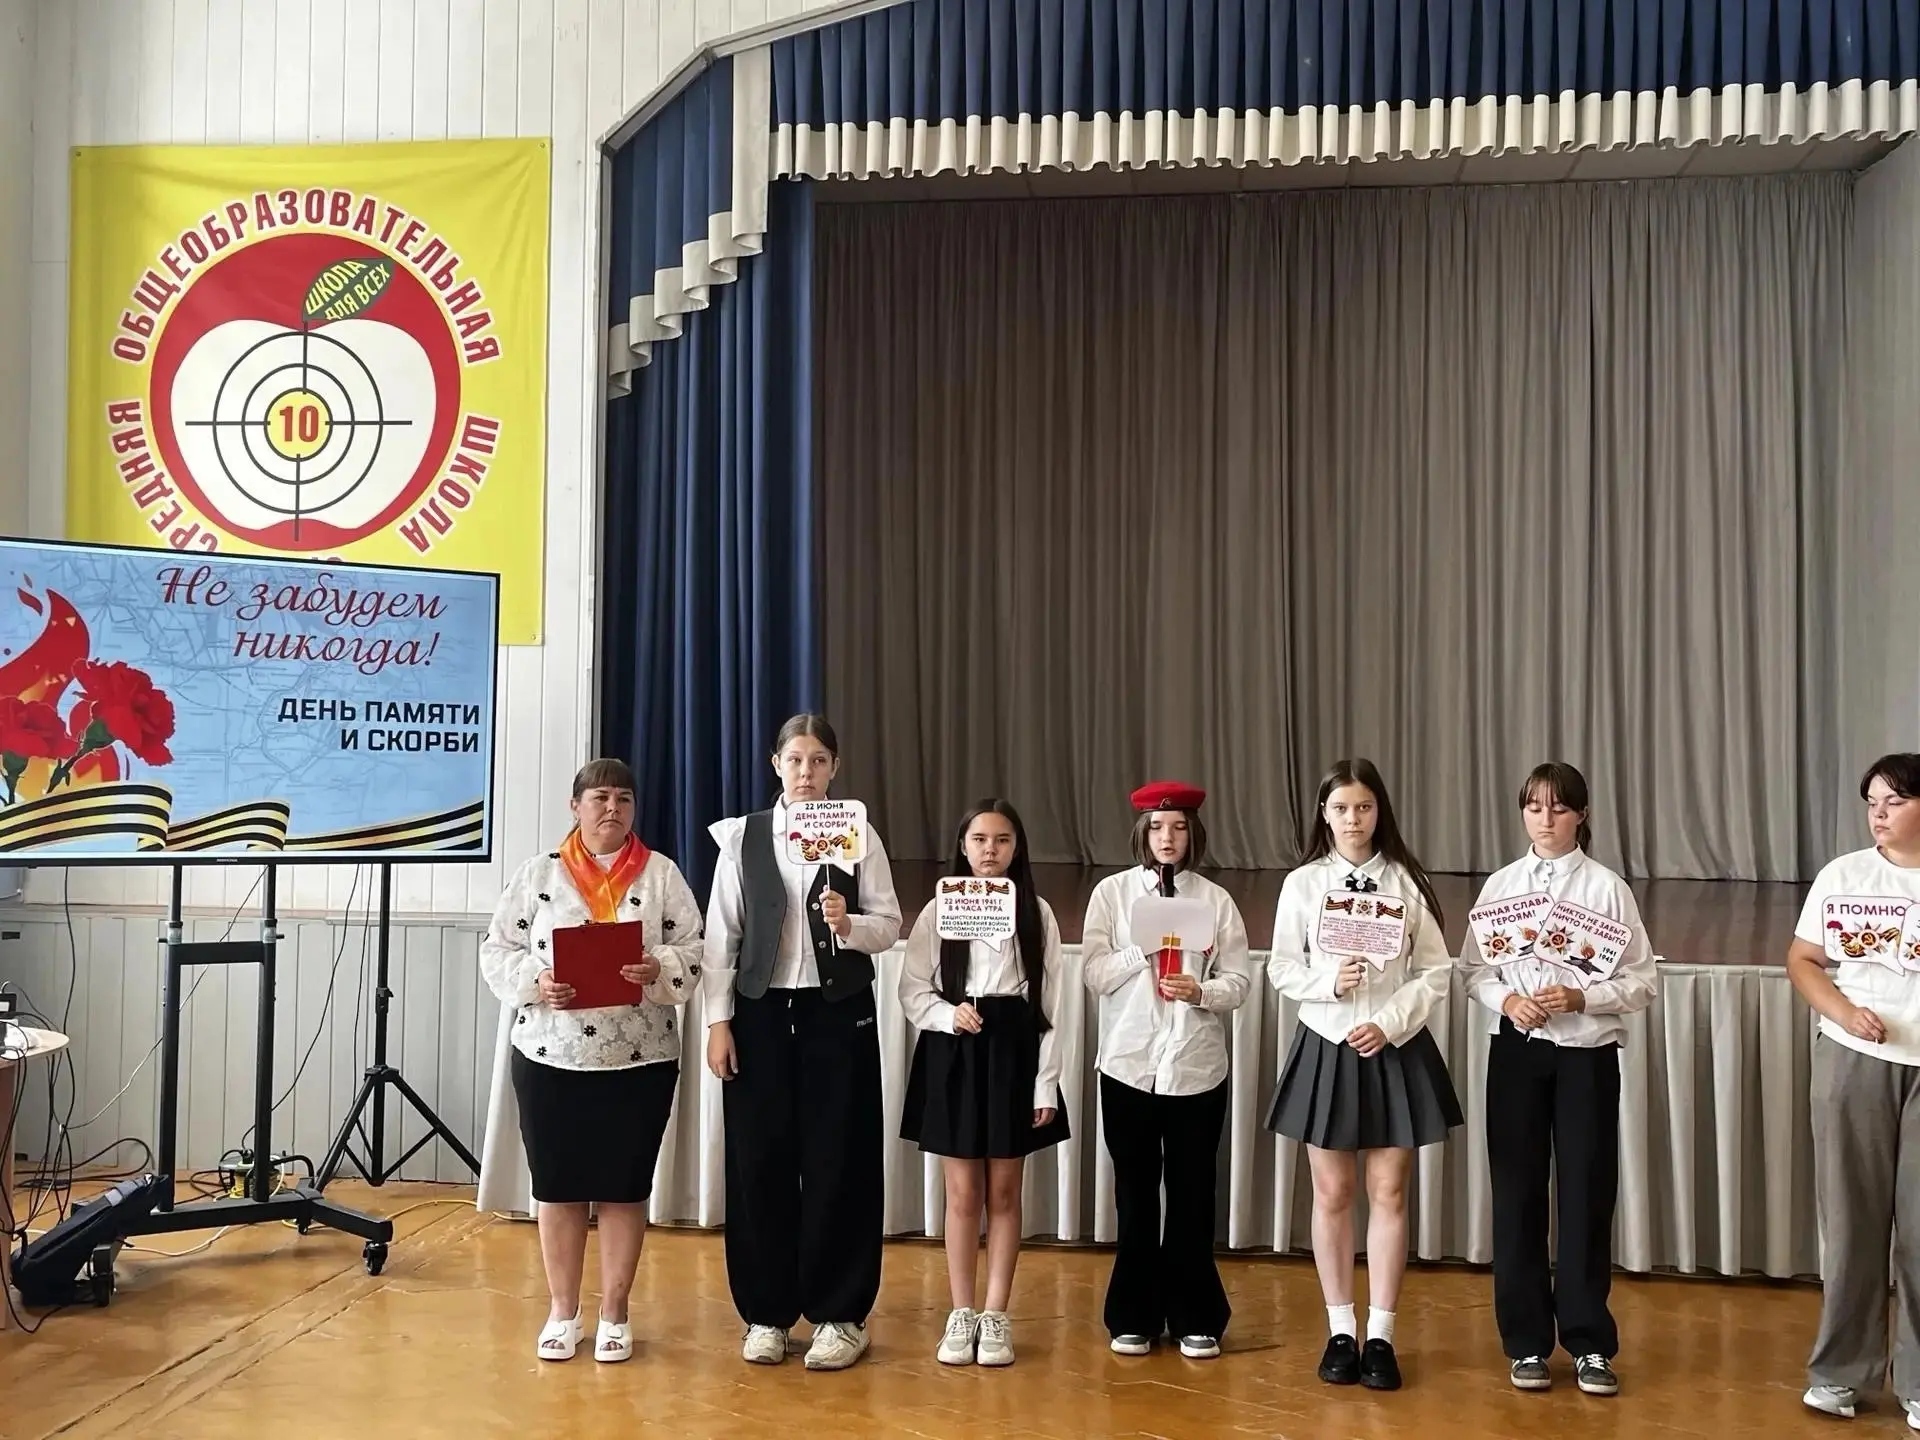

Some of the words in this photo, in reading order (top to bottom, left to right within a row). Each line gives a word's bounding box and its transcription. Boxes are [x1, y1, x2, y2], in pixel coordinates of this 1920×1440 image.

[305, 261, 368, 315] ШКОЛА
[325, 293, 360, 320] ДЛЯ
[354, 263, 390, 305] ВСЕХ
[114, 189, 500, 363] ОБЩЕОБРАЗОВАТЕЛЬНАЯ
[399, 415, 500, 552] ШКОЛА
[279, 405, 320, 443] 10
[156, 565, 234, 607] Не
[235, 572, 449, 628] забудем
[232, 631, 441, 676] никогда!
[277, 698, 356, 723] ДЕНЬ
[364, 700, 481, 725] ПАМЯТИ
[340, 729, 359, 750] И
[367, 729, 480, 753] СКОРБИ
[795, 812, 817, 821] ДЕНЬ
[819, 811, 856, 820] ПАМЯТИ
[816, 802, 844, 810] ИЮНЯ
[812, 820, 848, 828] СКОРБИ
[1470, 905, 1510, 921] ВЕЧНАЯ
[1512, 896, 1550, 911] СЛАВА
[1491, 909, 1537, 927] ГЕРОЯМ!
[1556, 904, 1586, 920] НИКТО
[1586, 916, 1599, 925] НЕ
[1826, 903, 1834, 914] Я
[1840, 903, 1905, 917] ПОМНЮ
[1552, 911, 1580, 927] НИЧТО
[1581, 923, 1594, 932] НЕ
[1593, 928, 1626, 946] ЗАБЫТО
[1598, 953, 1614, 964] 1945
[1602, 946, 1617, 957] 1941
